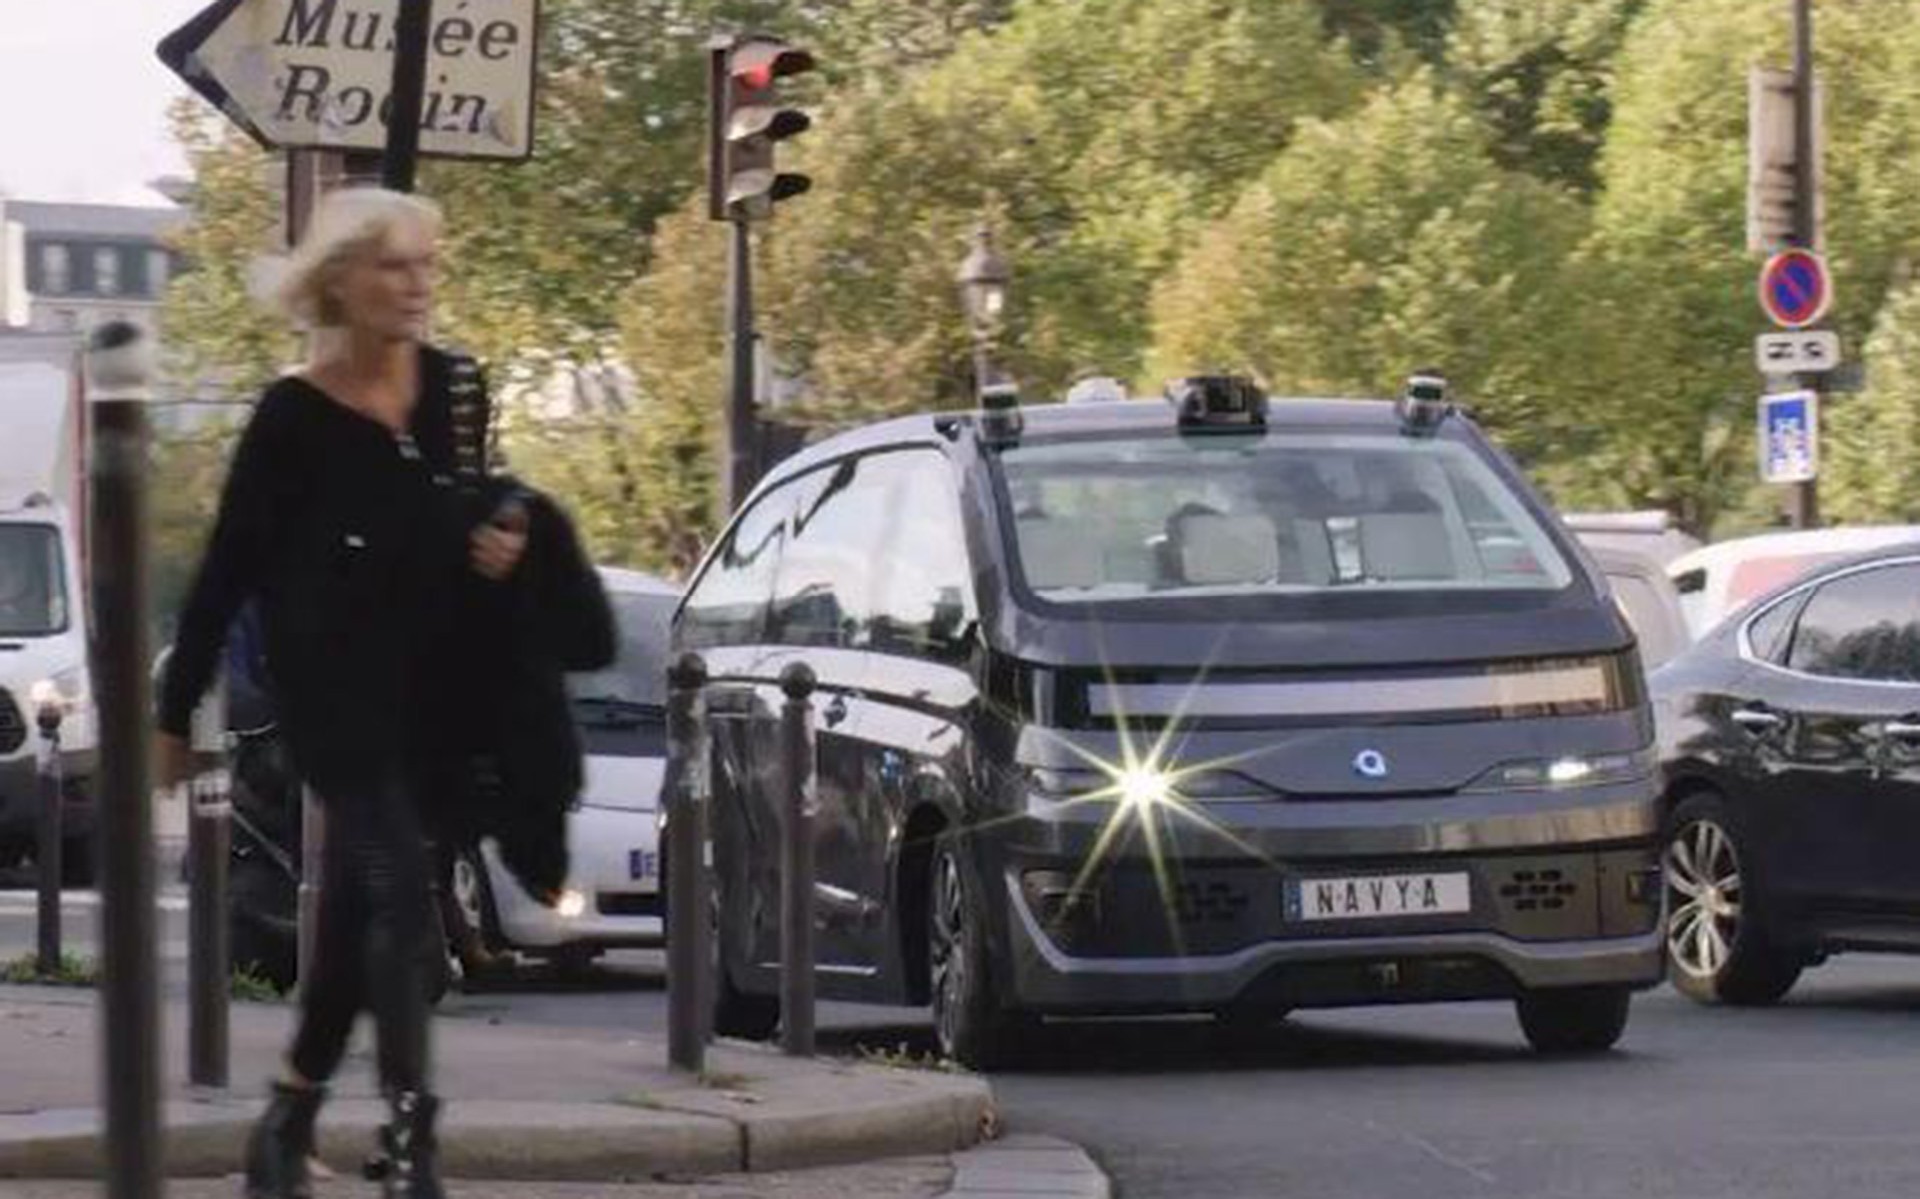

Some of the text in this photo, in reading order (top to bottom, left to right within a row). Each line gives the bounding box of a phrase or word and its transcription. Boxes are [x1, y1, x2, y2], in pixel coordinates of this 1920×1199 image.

[273, 0, 519, 61] Muée
[274, 63, 488, 135] Roin
[1316, 877, 1439, 914] NAVYA
